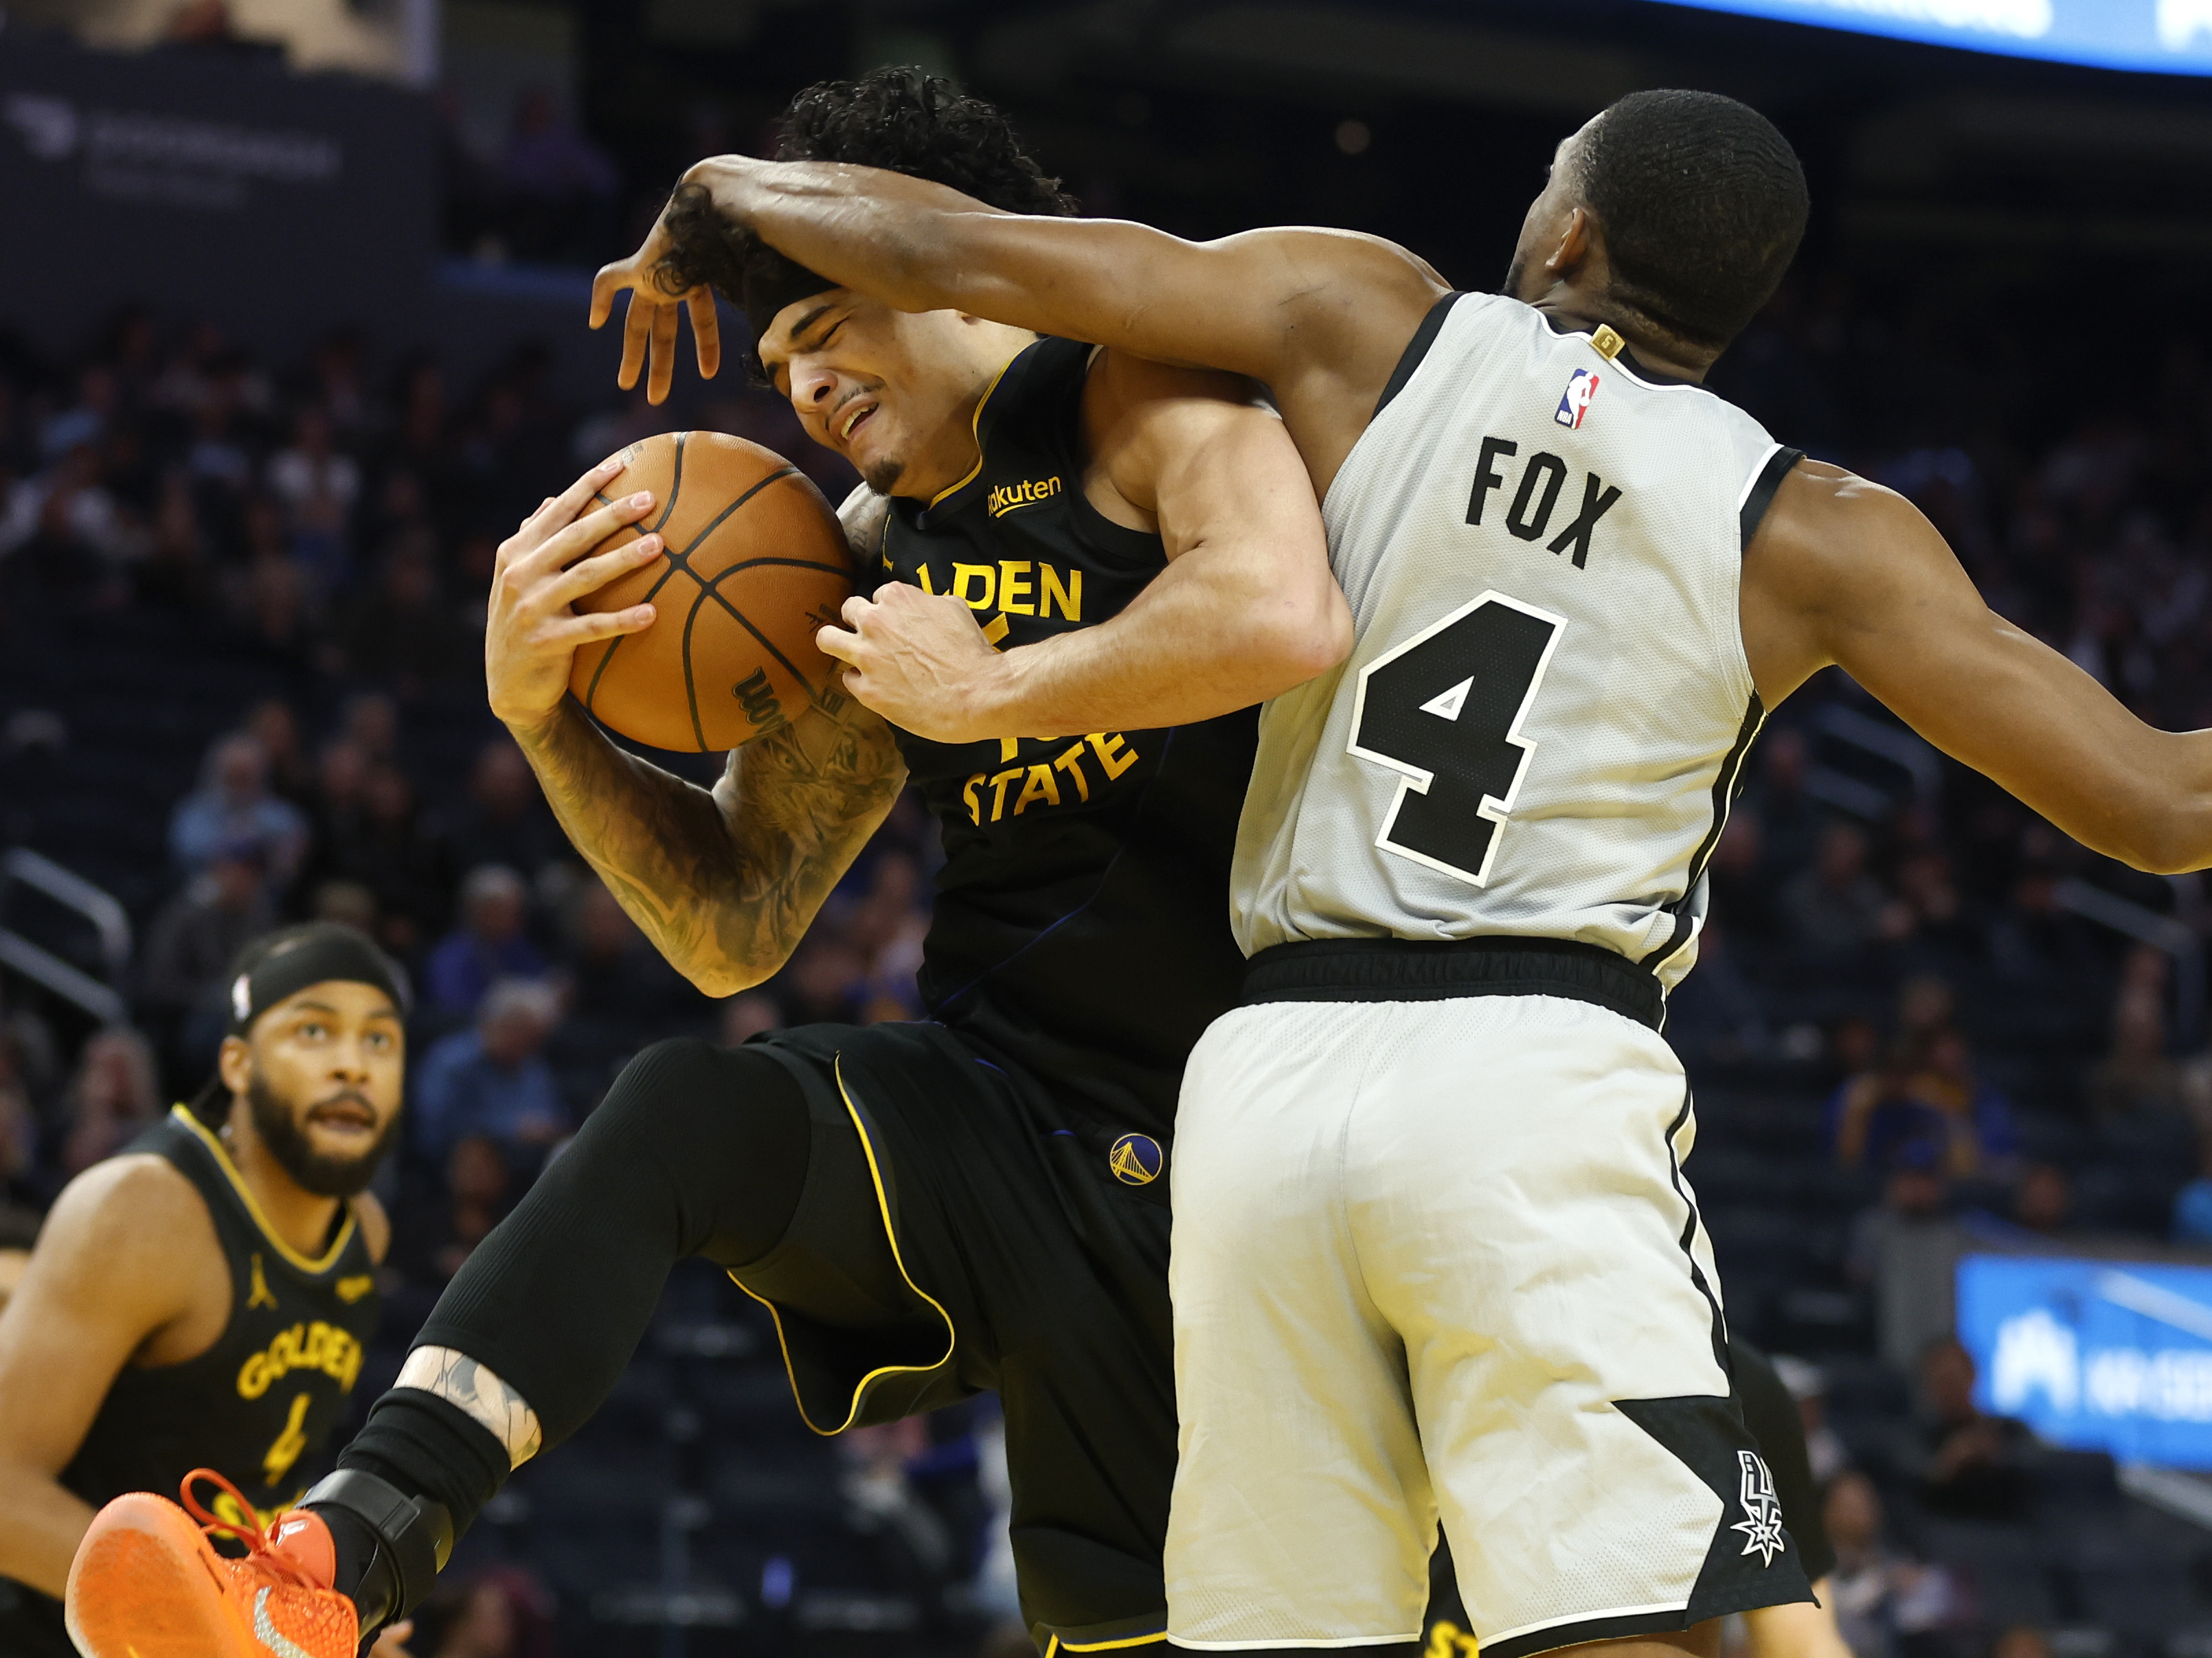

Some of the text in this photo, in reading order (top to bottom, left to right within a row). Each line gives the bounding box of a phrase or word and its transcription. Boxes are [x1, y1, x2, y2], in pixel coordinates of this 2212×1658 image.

[1557, 409, 1573, 424] NBA
[1465, 435, 1623, 570] FOX
[916, 560, 1082, 622] LDEN
[963, 732, 1139, 827] STATE
[1346, 589, 1569, 889] 4
[237, 1321, 363, 1399] GOLDEN
